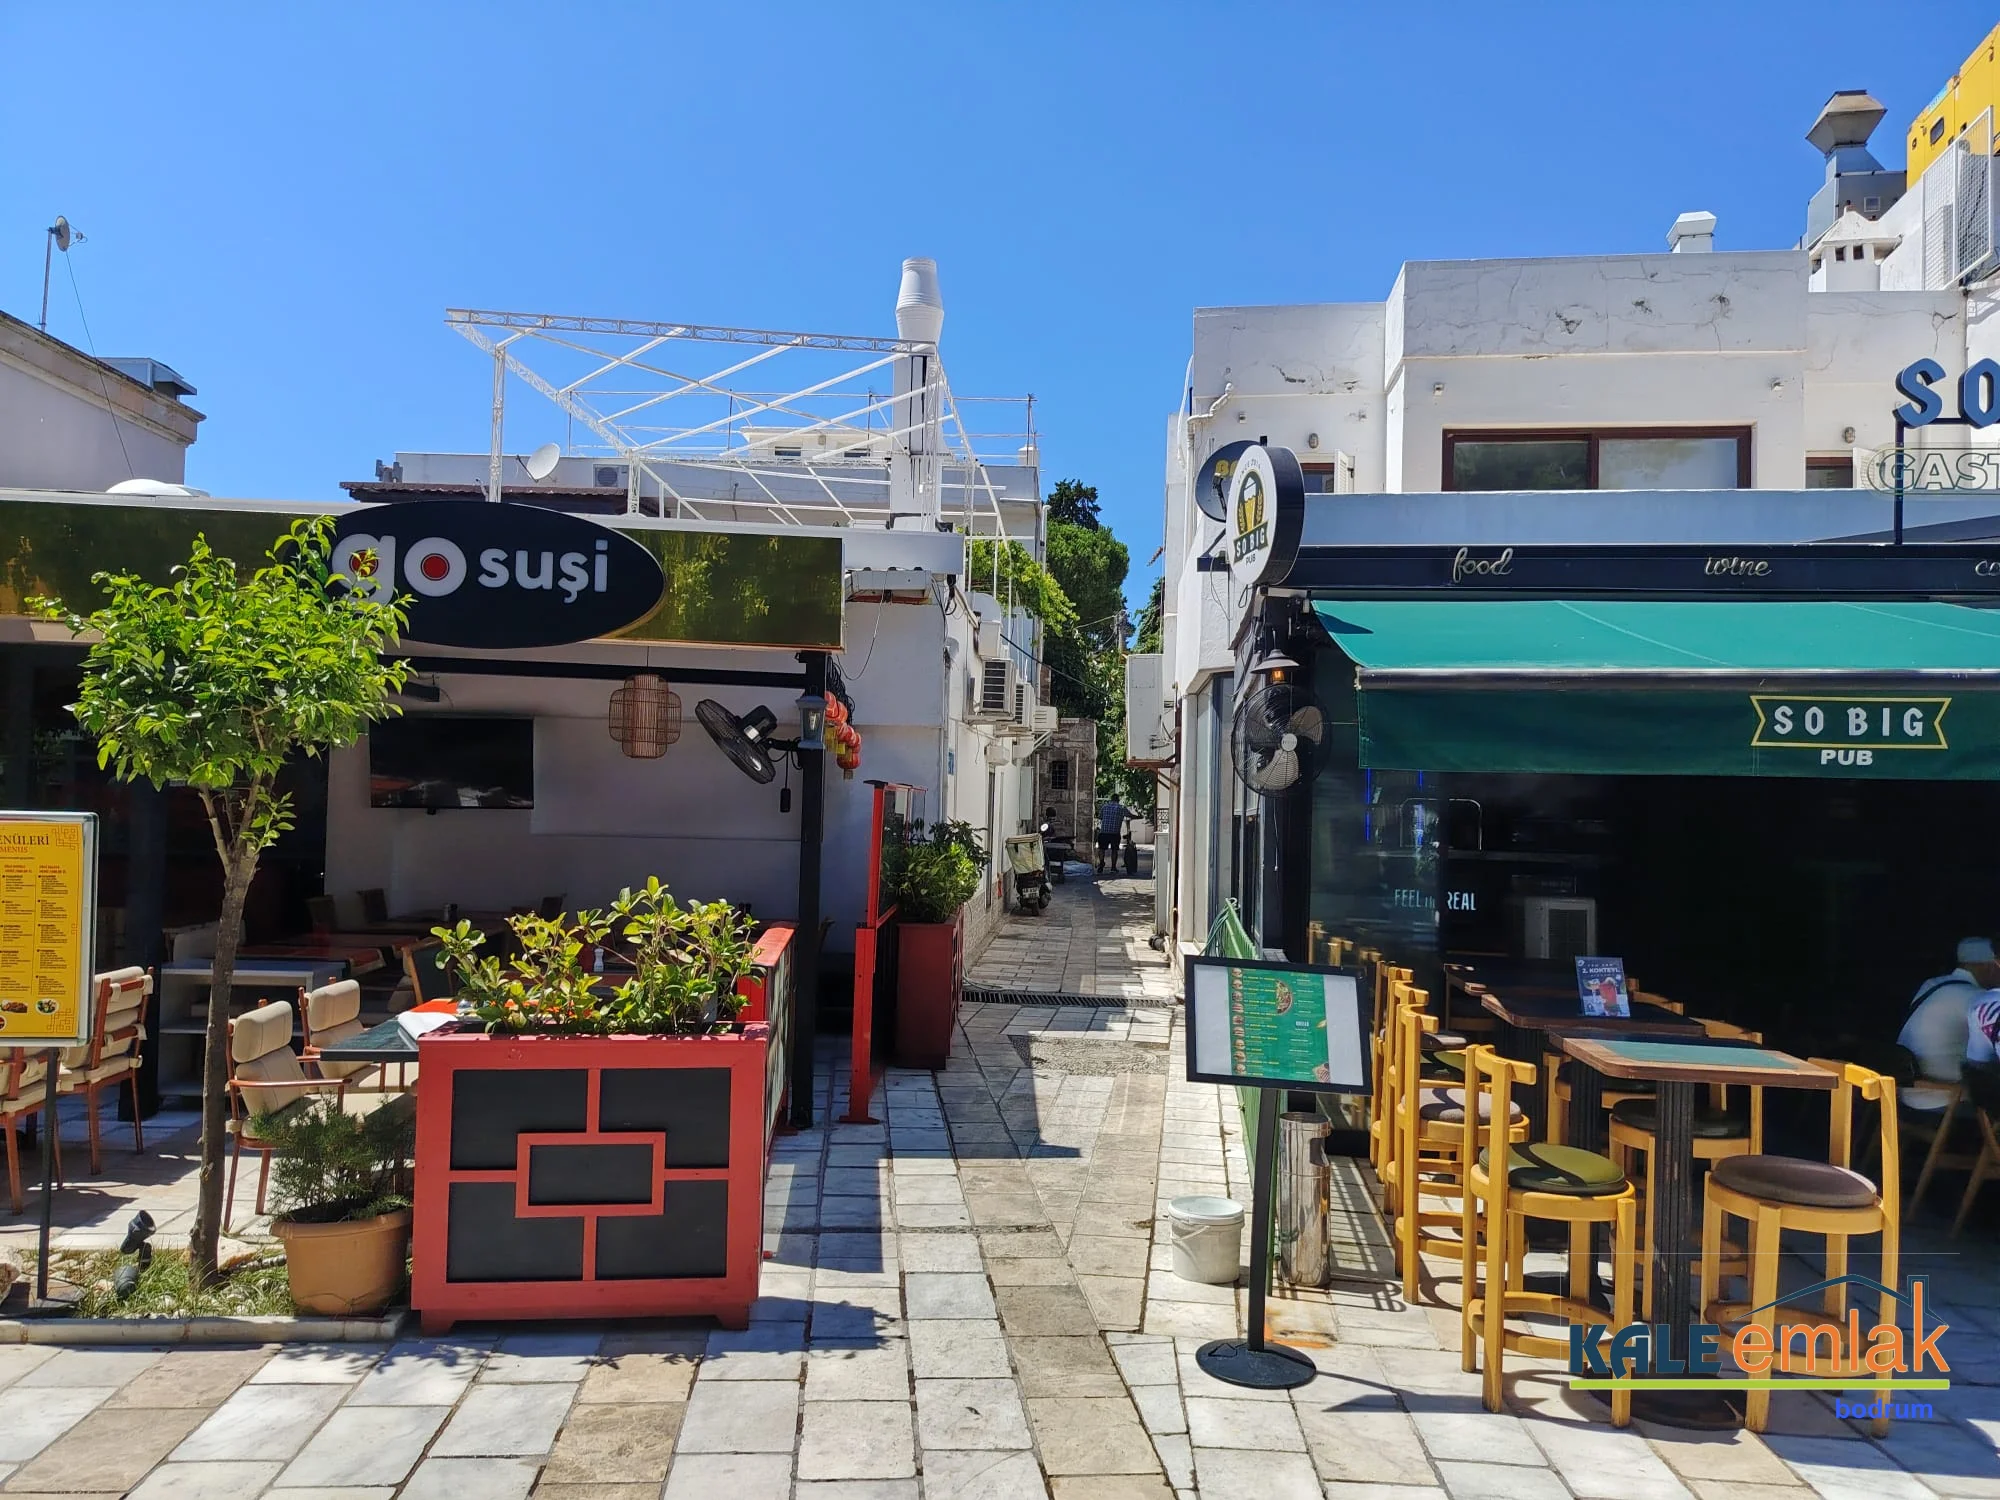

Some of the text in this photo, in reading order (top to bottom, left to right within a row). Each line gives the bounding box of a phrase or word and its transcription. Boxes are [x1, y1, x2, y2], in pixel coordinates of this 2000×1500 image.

[1893, 357, 2000, 430] SO
[1236, 527, 1265, 558] SO BIG
[332, 533, 608, 606] go suşi
[1245, 553, 1256, 566] PUB
[1453, 547, 1514, 583] food
[1705, 556, 1772, 577] wine
[1773, 705, 1924, 737] SO BIG
[1820, 749, 1874, 766] PUB
[1394, 889, 1421, 908] FEEL
